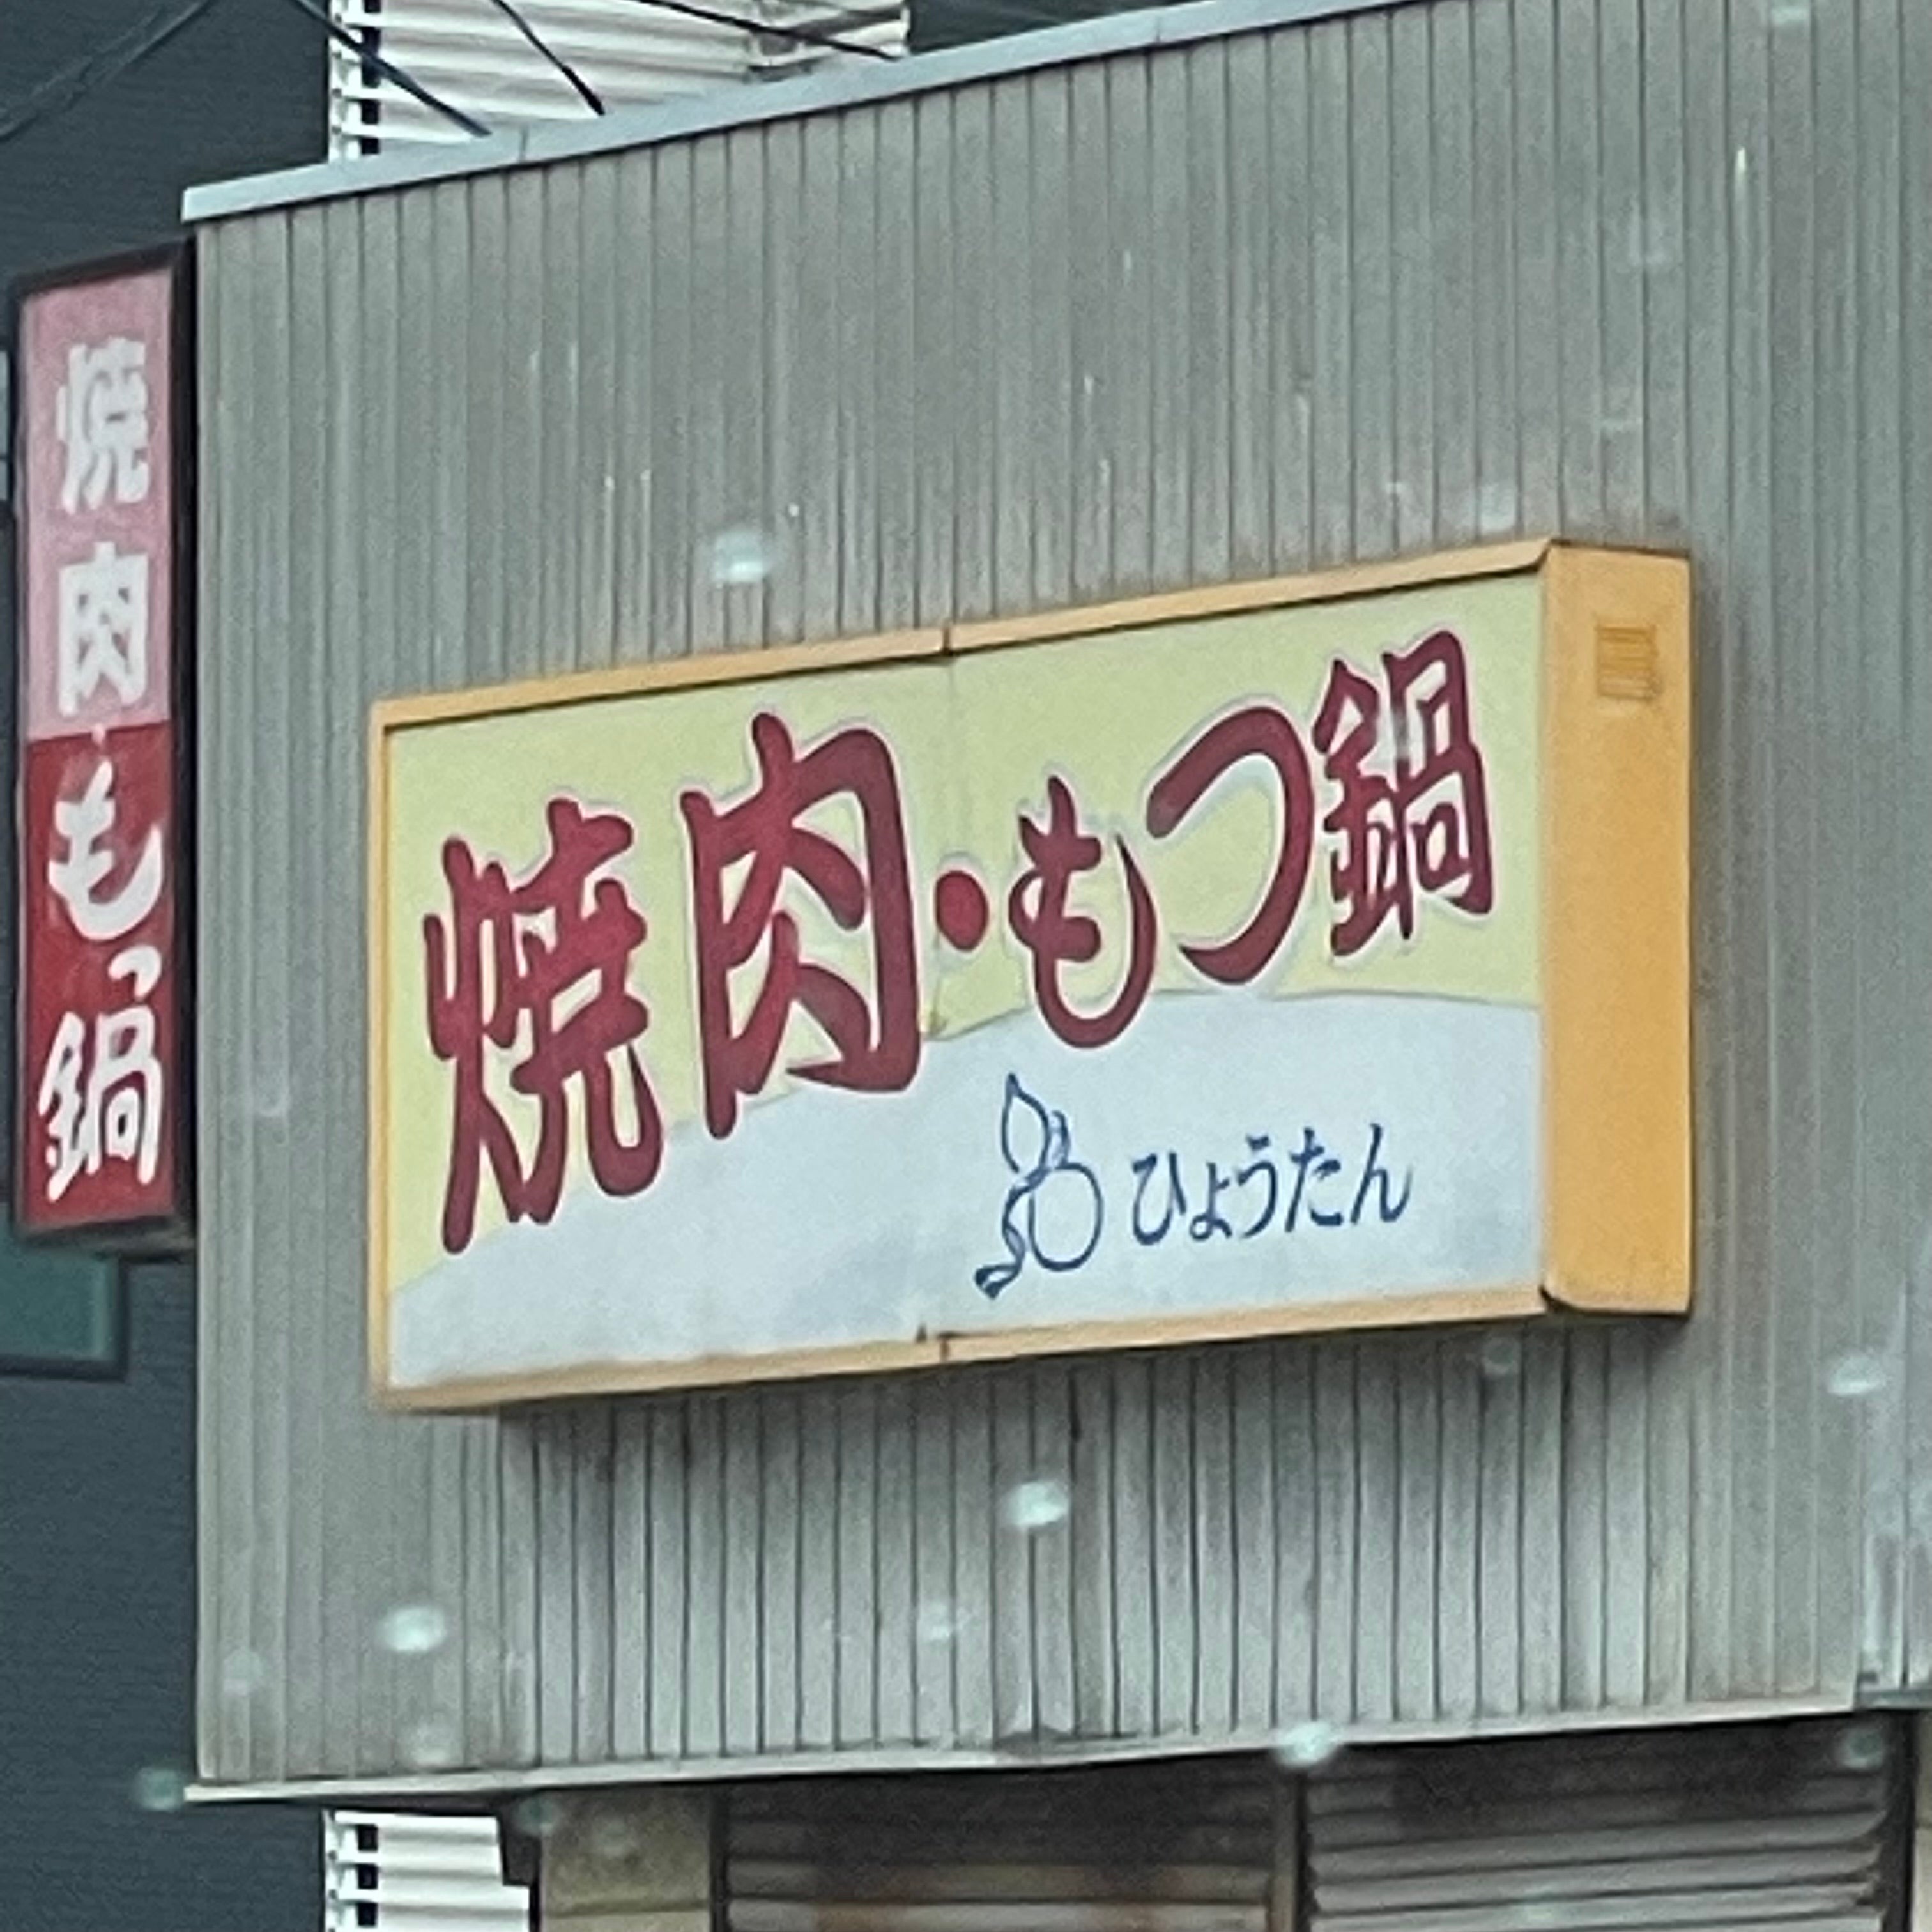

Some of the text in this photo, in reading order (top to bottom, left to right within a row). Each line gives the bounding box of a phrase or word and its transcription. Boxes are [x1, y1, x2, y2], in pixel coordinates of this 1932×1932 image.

[422, 629, 1494, 1255] 焼肉・もつ鍋
[1131, 1123, 1413, 1246] ひょうたん
